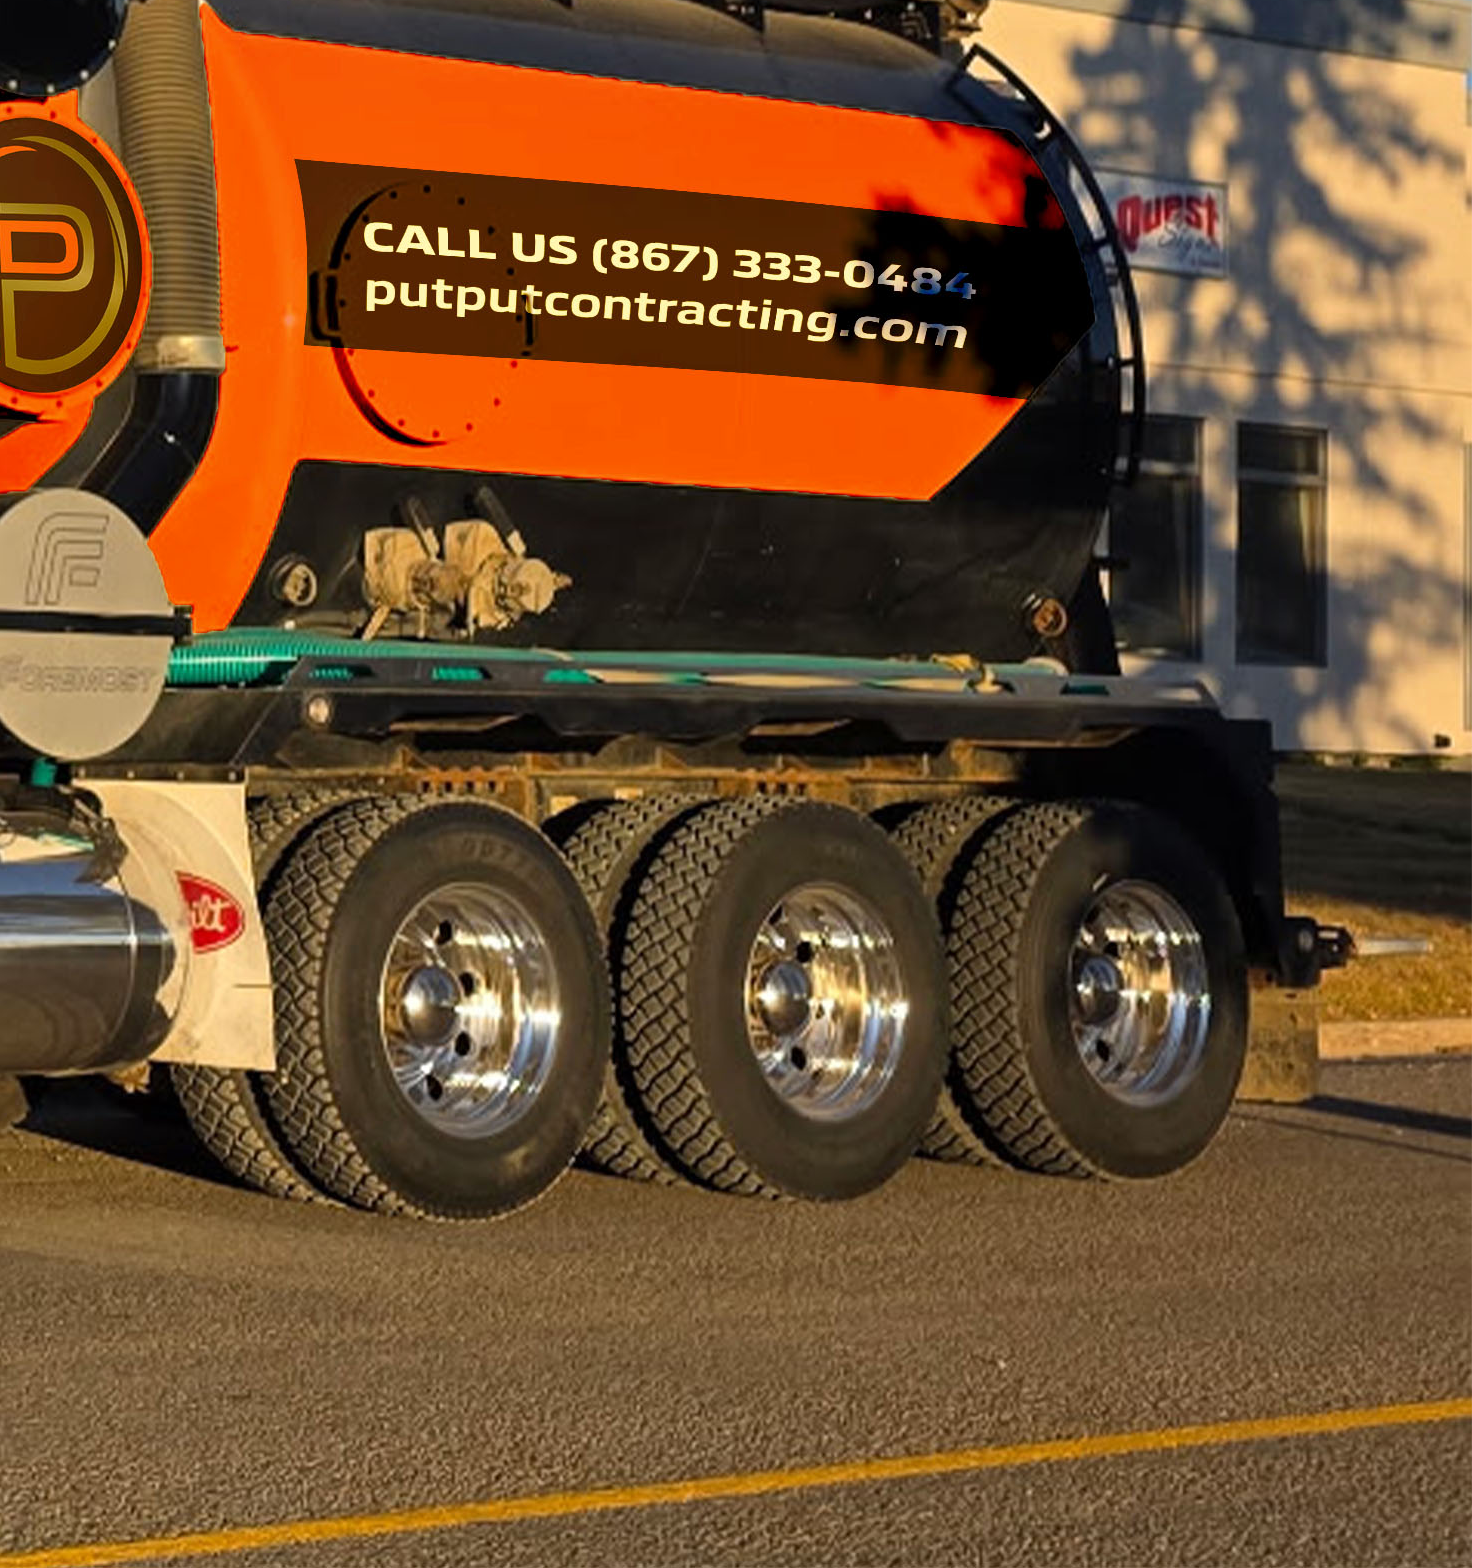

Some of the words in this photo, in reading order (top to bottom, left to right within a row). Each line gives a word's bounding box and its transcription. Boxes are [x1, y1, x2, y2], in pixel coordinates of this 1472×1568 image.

[1117, 192, 1222, 253] Quest
[363, 222, 497, 260] CALL
[512, 232, 578, 265] US
[592, 238, 719, 282] (867)
[733, 249, 977, 301] 333-0484
[366, 273, 968, 349] putputcontracting.com
